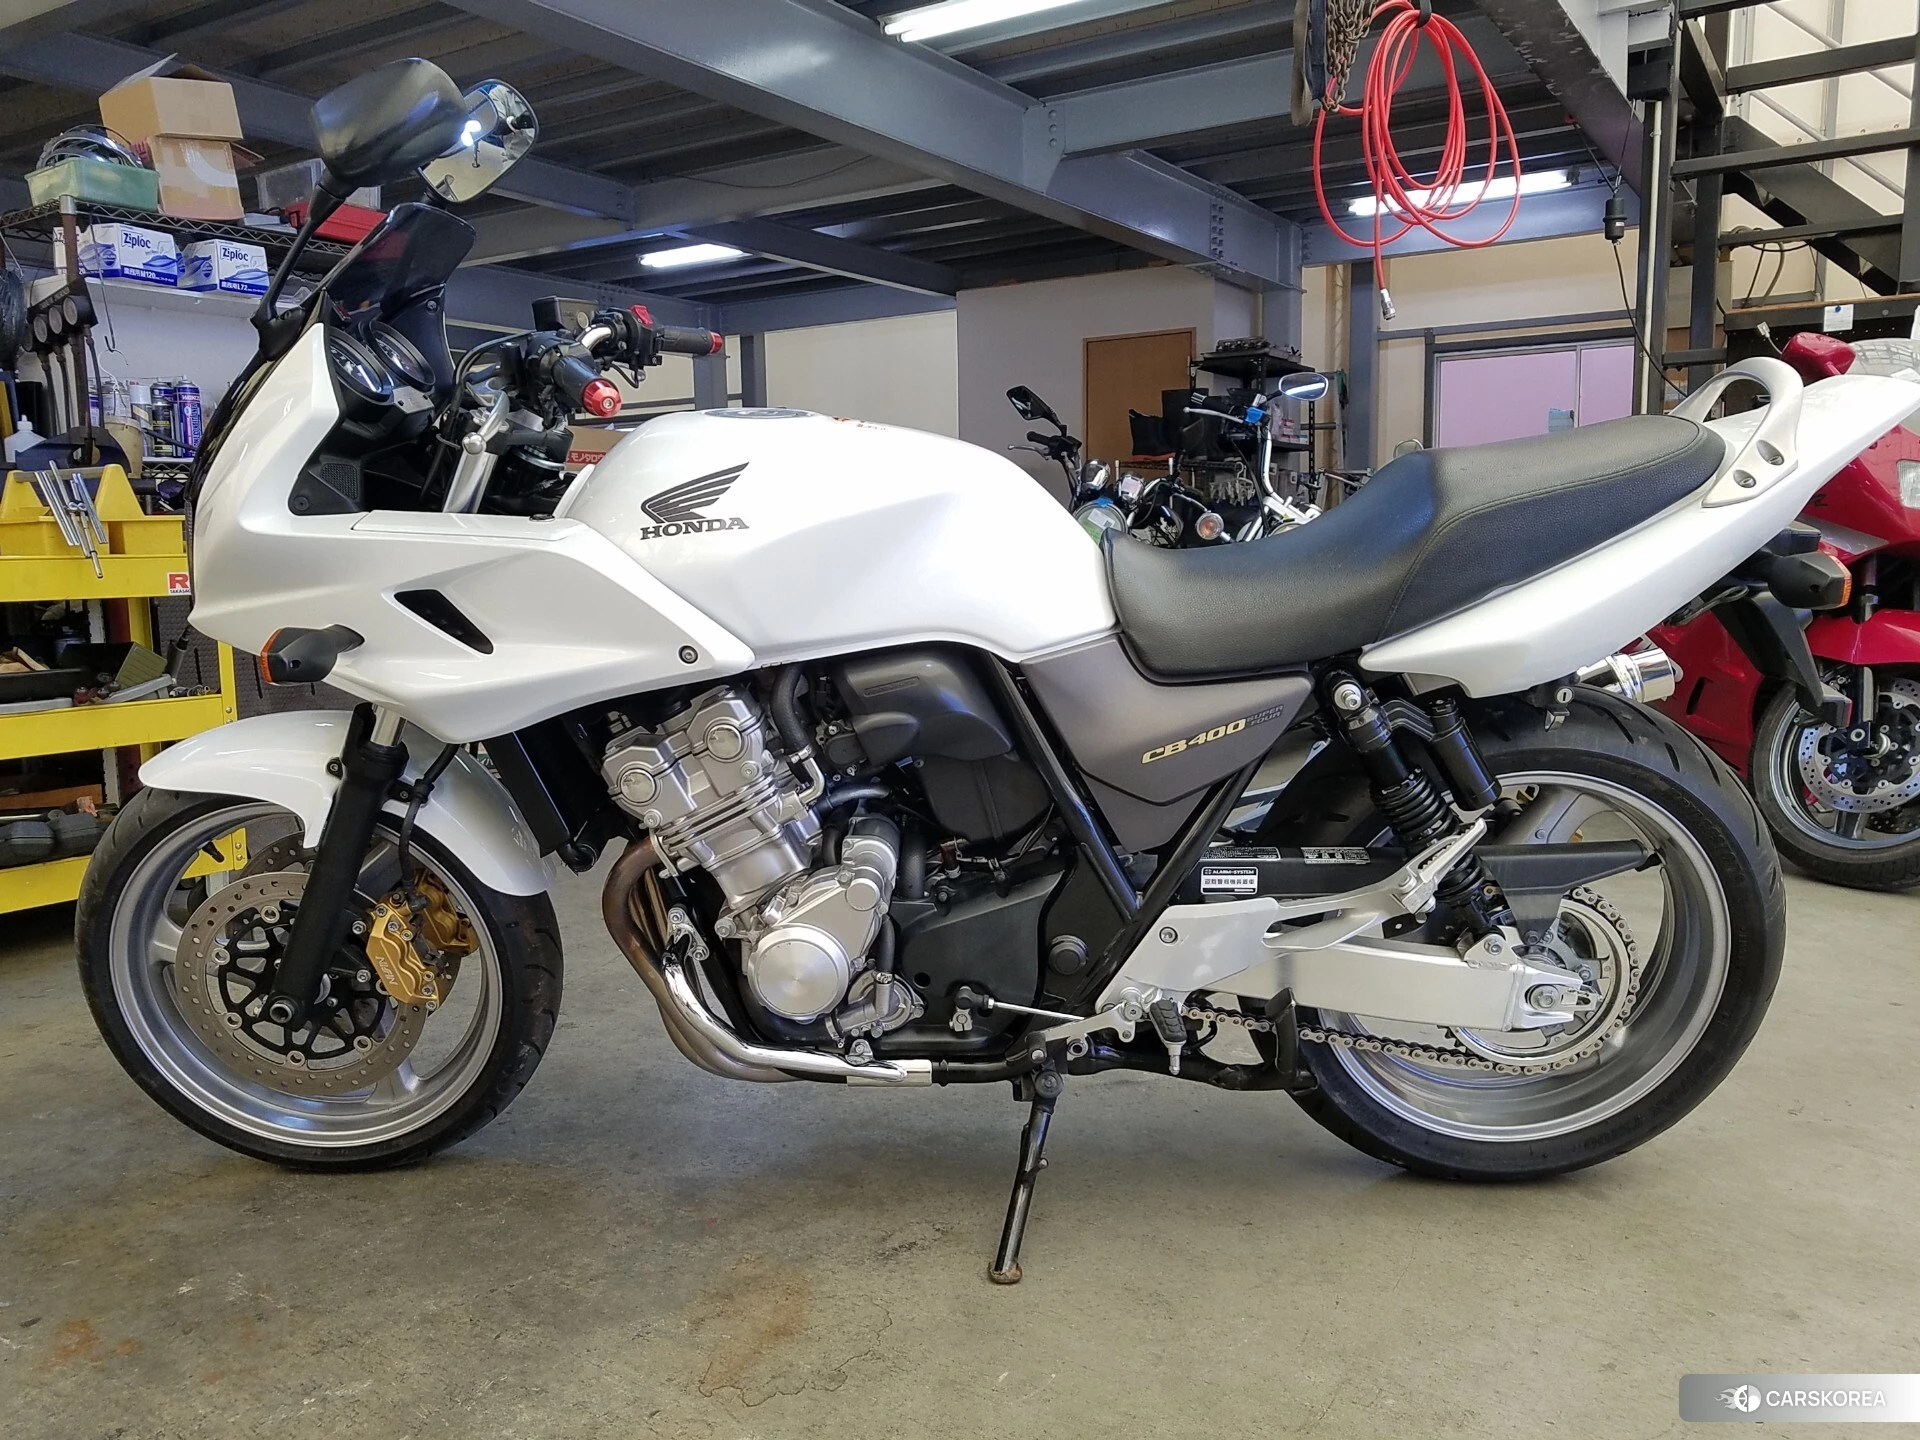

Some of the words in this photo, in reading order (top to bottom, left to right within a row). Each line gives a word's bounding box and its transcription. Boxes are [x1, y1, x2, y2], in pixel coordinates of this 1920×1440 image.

[123, 232, 151, 249] Ziploc
[222, 247, 249, 261] Ziploc
[640, 517, 750, 540] HONDA
[169, 573, 189, 589] R
[1247, 704, 1285, 722] SUPER
[1250, 711, 1282, 727] FOUR
[1141, 718, 1247, 764] CB400
